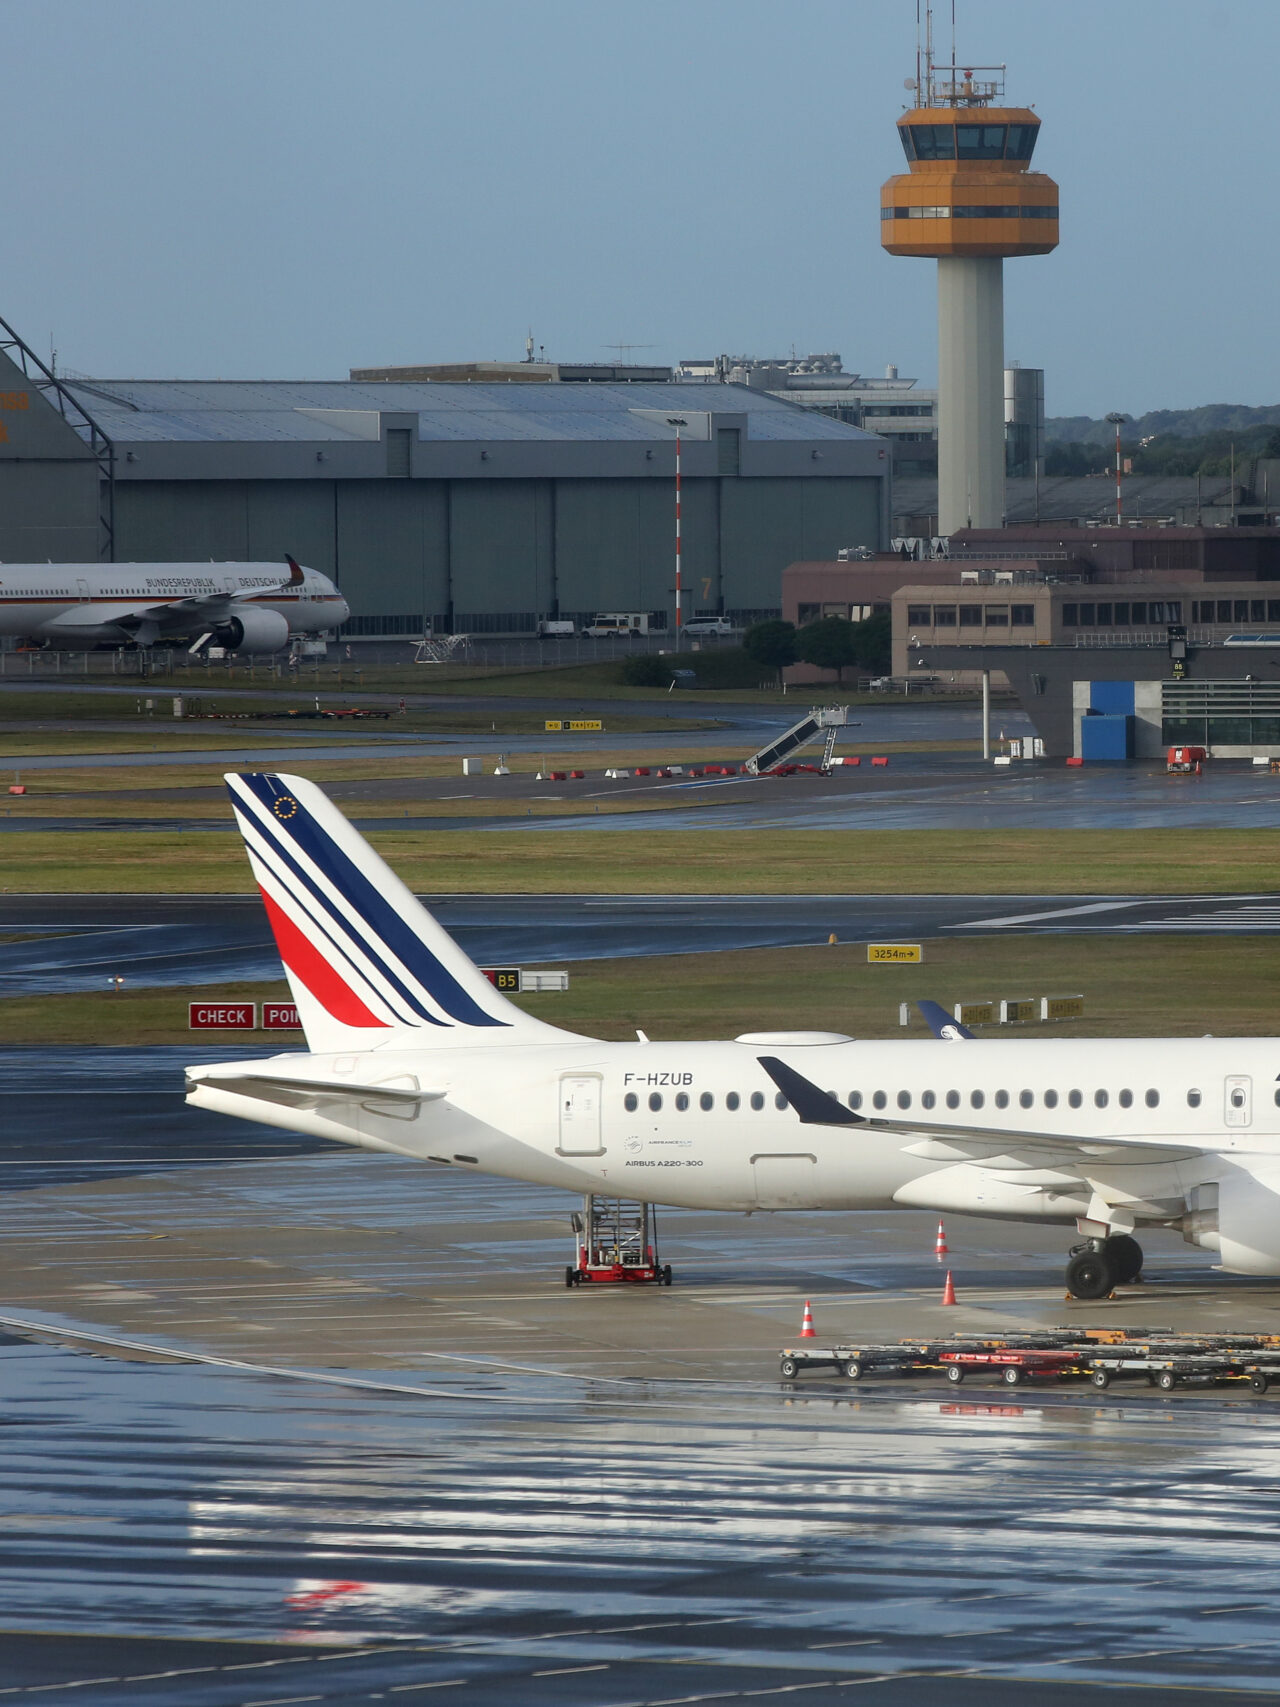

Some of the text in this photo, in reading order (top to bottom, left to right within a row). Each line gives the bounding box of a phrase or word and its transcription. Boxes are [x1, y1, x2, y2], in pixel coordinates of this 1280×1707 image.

[146, 578, 215, 587] BUNDESREPUBLIK
[702, 578, 712, 600] 7
[874, 949, 906, 959] 3254m
[498, 975, 516, 987] B5
[197, 1010, 300, 1023] CHECK POI
[624, 1072, 693, 1086] F-HZUB
